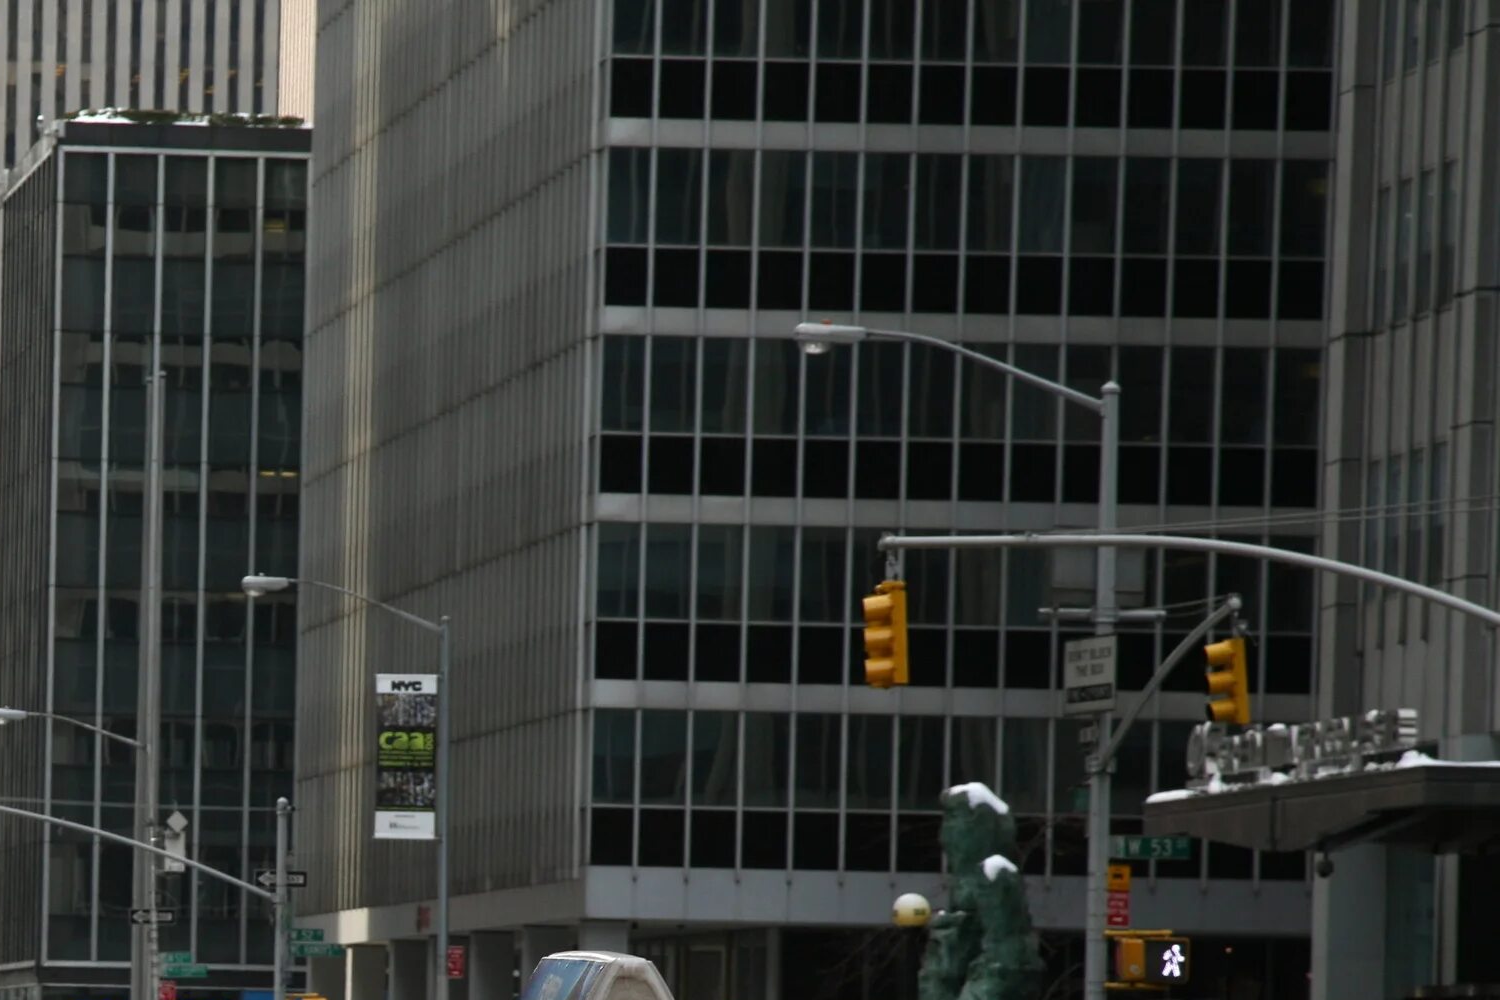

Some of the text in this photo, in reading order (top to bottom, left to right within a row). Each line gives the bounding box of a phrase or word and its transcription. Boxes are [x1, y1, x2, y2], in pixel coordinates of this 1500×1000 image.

[391, 680, 422, 692] NYC
[1128, 838, 1141, 855] W
[1151, 838, 1173, 856] 53
